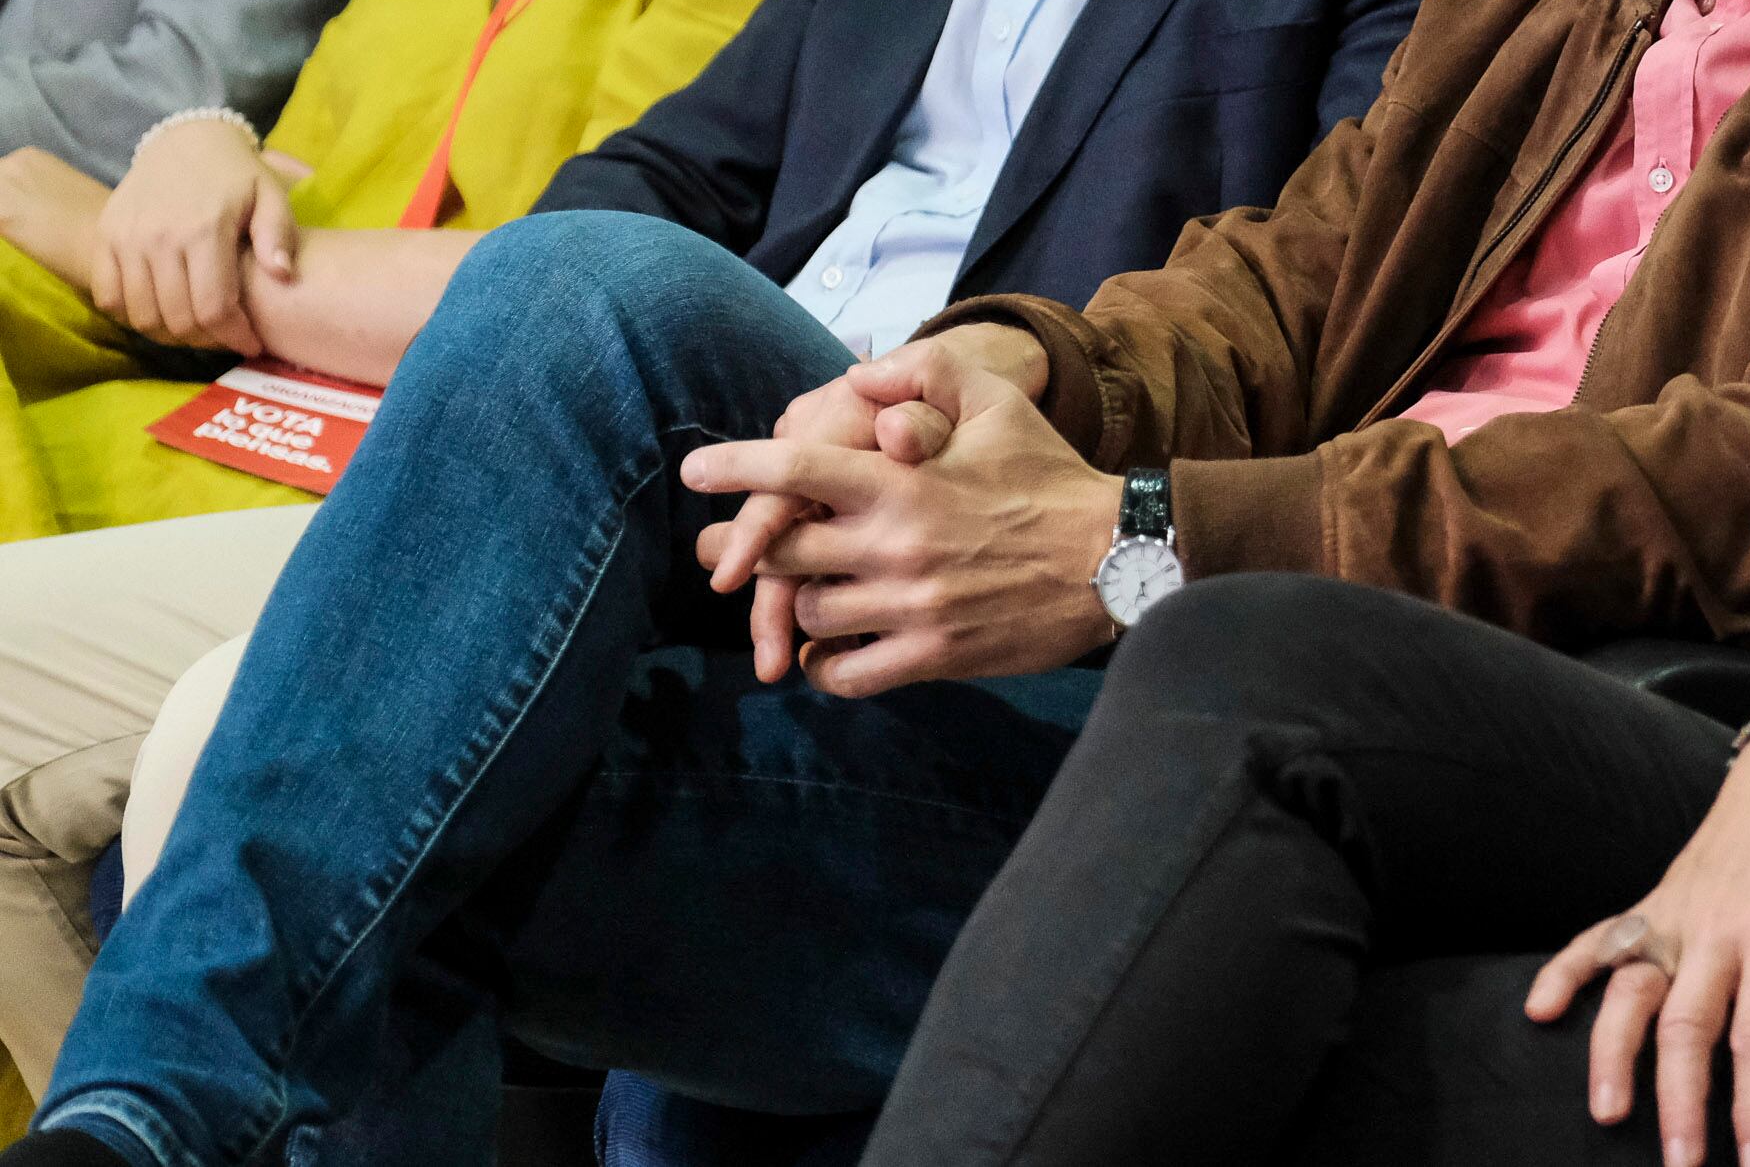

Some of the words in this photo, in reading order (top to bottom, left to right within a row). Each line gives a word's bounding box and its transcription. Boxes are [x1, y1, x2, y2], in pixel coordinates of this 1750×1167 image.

[212, 408, 247, 431] lo
[248, 422, 315, 450] que
[234, 396, 324, 437] VOTA
